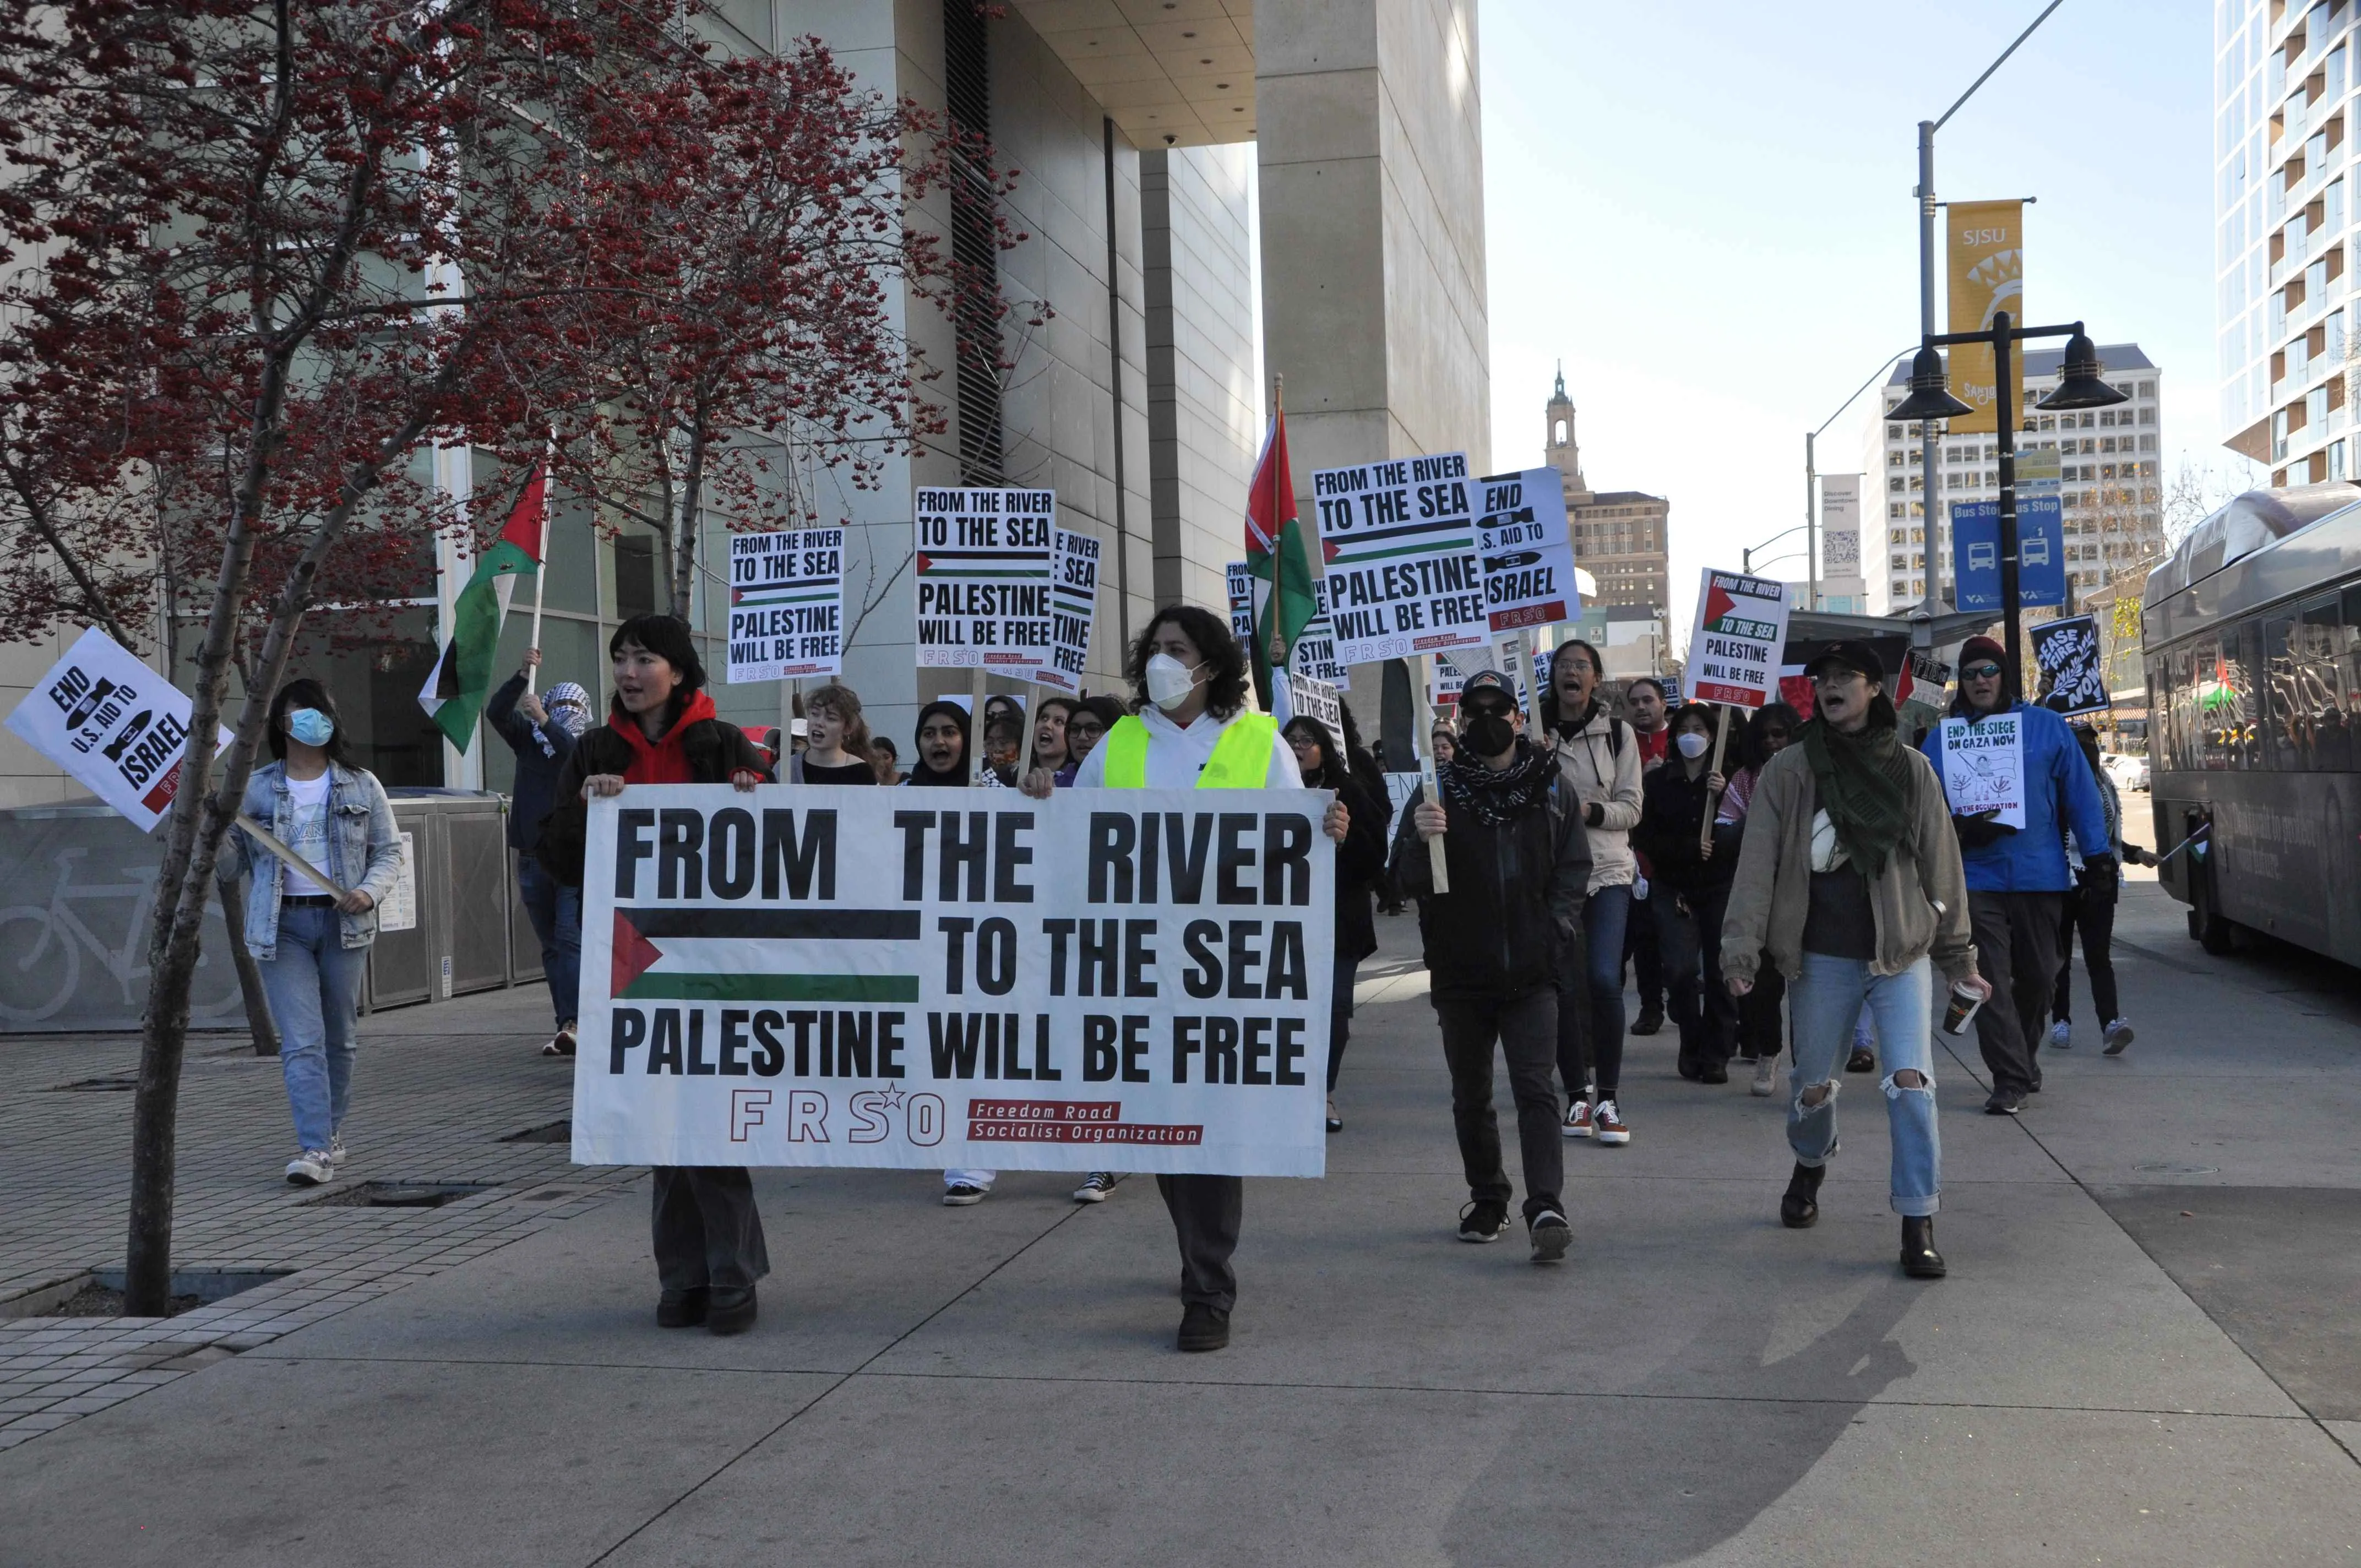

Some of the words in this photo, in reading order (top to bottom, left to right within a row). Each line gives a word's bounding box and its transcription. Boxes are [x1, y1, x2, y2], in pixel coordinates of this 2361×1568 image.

[1963, 228, 2005, 246] SJSU
[1314, 468, 1368, 496] FROM
[1373, 461, 1408, 487] THE
[1412, 455, 1466, 482] RIVER
[918, 491, 965, 512] FROM
[971, 492, 1000, 513] THE
[1005, 492, 1052, 513] RIVER
[1319, 498, 1353, 532] TO
[1360, 489, 1411, 526] THE
[1417, 482, 1470, 518] SEA
[1485, 483, 1522, 513] END
[2016, 503, 2028, 513] us
[2032, 500, 2058, 513] Stop
[1955, 507, 1976, 518] Bus
[733, 536, 771, 555] FROM
[775, 533, 798, 551] THE
[803, 530, 842, 548] RIVER
[918, 516, 947, 546] TO
[956, 517, 998, 546] THE
[1006, 518, 1050, 547] SEA
[1500, 526, 1522, 546] AID
[1526, 522, 1543, 541] TO
[1067, 534, 1099, 559] RIVER
[733, 557, 756, 582] TO
[763, 553, 797, 579] THE
[803, 551, 840, 576] SEA
[1064, 557, 1095, 589] SEA
[1230, 579, 1245, 594] TO
[1329, 554, 1481, 609] PALESTINE
[1713, 575, 1738, 591] FROM
[1739, 580, 1754, 593] THE
[1756, 582, 1780, 597] RIVER
[919, 584, 1051, 617] PALESTINE
[732, 605, 839, 640] PALESTINE
[1332, 608, 1389, 641] WILL
[1395, 602, 1425, 632] BE
[1430, 594, 1486, 627] FREE
[1500, 607, 1545, 627] FRSO
[1720, 618, 1733, 632] TO
[1735, 620, 1755, 635] THE
[1756, 624, 1776, 639] SEA
[918, 619, 965, 645] WILL
[972, 620, 997, 645] BE
[1004, 621, 1051, 646] FREE
[730, 641, 769, 664] WILL
[775, 638, 795, 660] BE
[801, 635, 839, 658] FREE
[924, 650, 978, 665] FRSO
[1053, 645, 1086, 675] FREE
[1345, 638, 1407, 662] FRSO
[1534, 656, 1545, 667] HE
[1706, 638, 1768, 663] PALESTINE
[2038, 629, 2077, 670] CEASE
[2050, 642, 2076, 670] FIRE
[735, 665, 780, 681] FRSO
[1293, 674, 1309, 691] FROM
[1309, 680, 1320, 695] THE
[1440, 682, 1454, 690] WILL
[1456, 680, 1463, 689] BE
[1535, 668, 1548, 684] HE
[1703, 663, 1726, 678] WILL
[1729, 667, 1740, 680] BE
[1744, 669, 1765, 684] FREE
[48, 666, 90, 714] END
[1713, 687, 1750, 701] FRSO
[71, 728, 104, 754] U.S.
[94, 702, 122, 729] AID
[112, 684, 137, 706] TO
[1295, 692, 1304, 714] TO
[1307, 696, 1323, 718] THE
[1324, 701, 1340, 726] SEA
[1947, 725, 1965, 738] END
[1967, 722, 1985, 736] THE
[1987, 721, 2015, 735] SIEGE
[1948, 739, 1961, 750] ON
[1963, 737, 1990, 749] GAZA
[1993, 734, 2015, 746] NOW
[118, 712, 189, 791] ISRAEL
[1975, 802, 2017, 811] OCCUPATION
[614, 807, 837, 901] FROM
[894, 810, 1035, 903] THE
[1087, 812, 1313, 906] RIVER
[938, 917, 1018, 996] TO
[1042, 918, 1157, 998] THE
[1182, 918, 1309, 1000] SEA
[610, 1008, 905, 1079] PALESTINE
[927, 1011, 1062, 1081] WILL
[1082, 1015, 1150, 1083] BE
[1172, 1016, 1305, 1086] FREE
[730, 1088, 946, 1147] FRSO
[975, 1103, 1056, 1119] Freedom
[1065, 1104, 1113, 1120] Road
[975, 1123, 1067, 1140] Socialist
[1071, 1124, 1198, 1143] Organization
